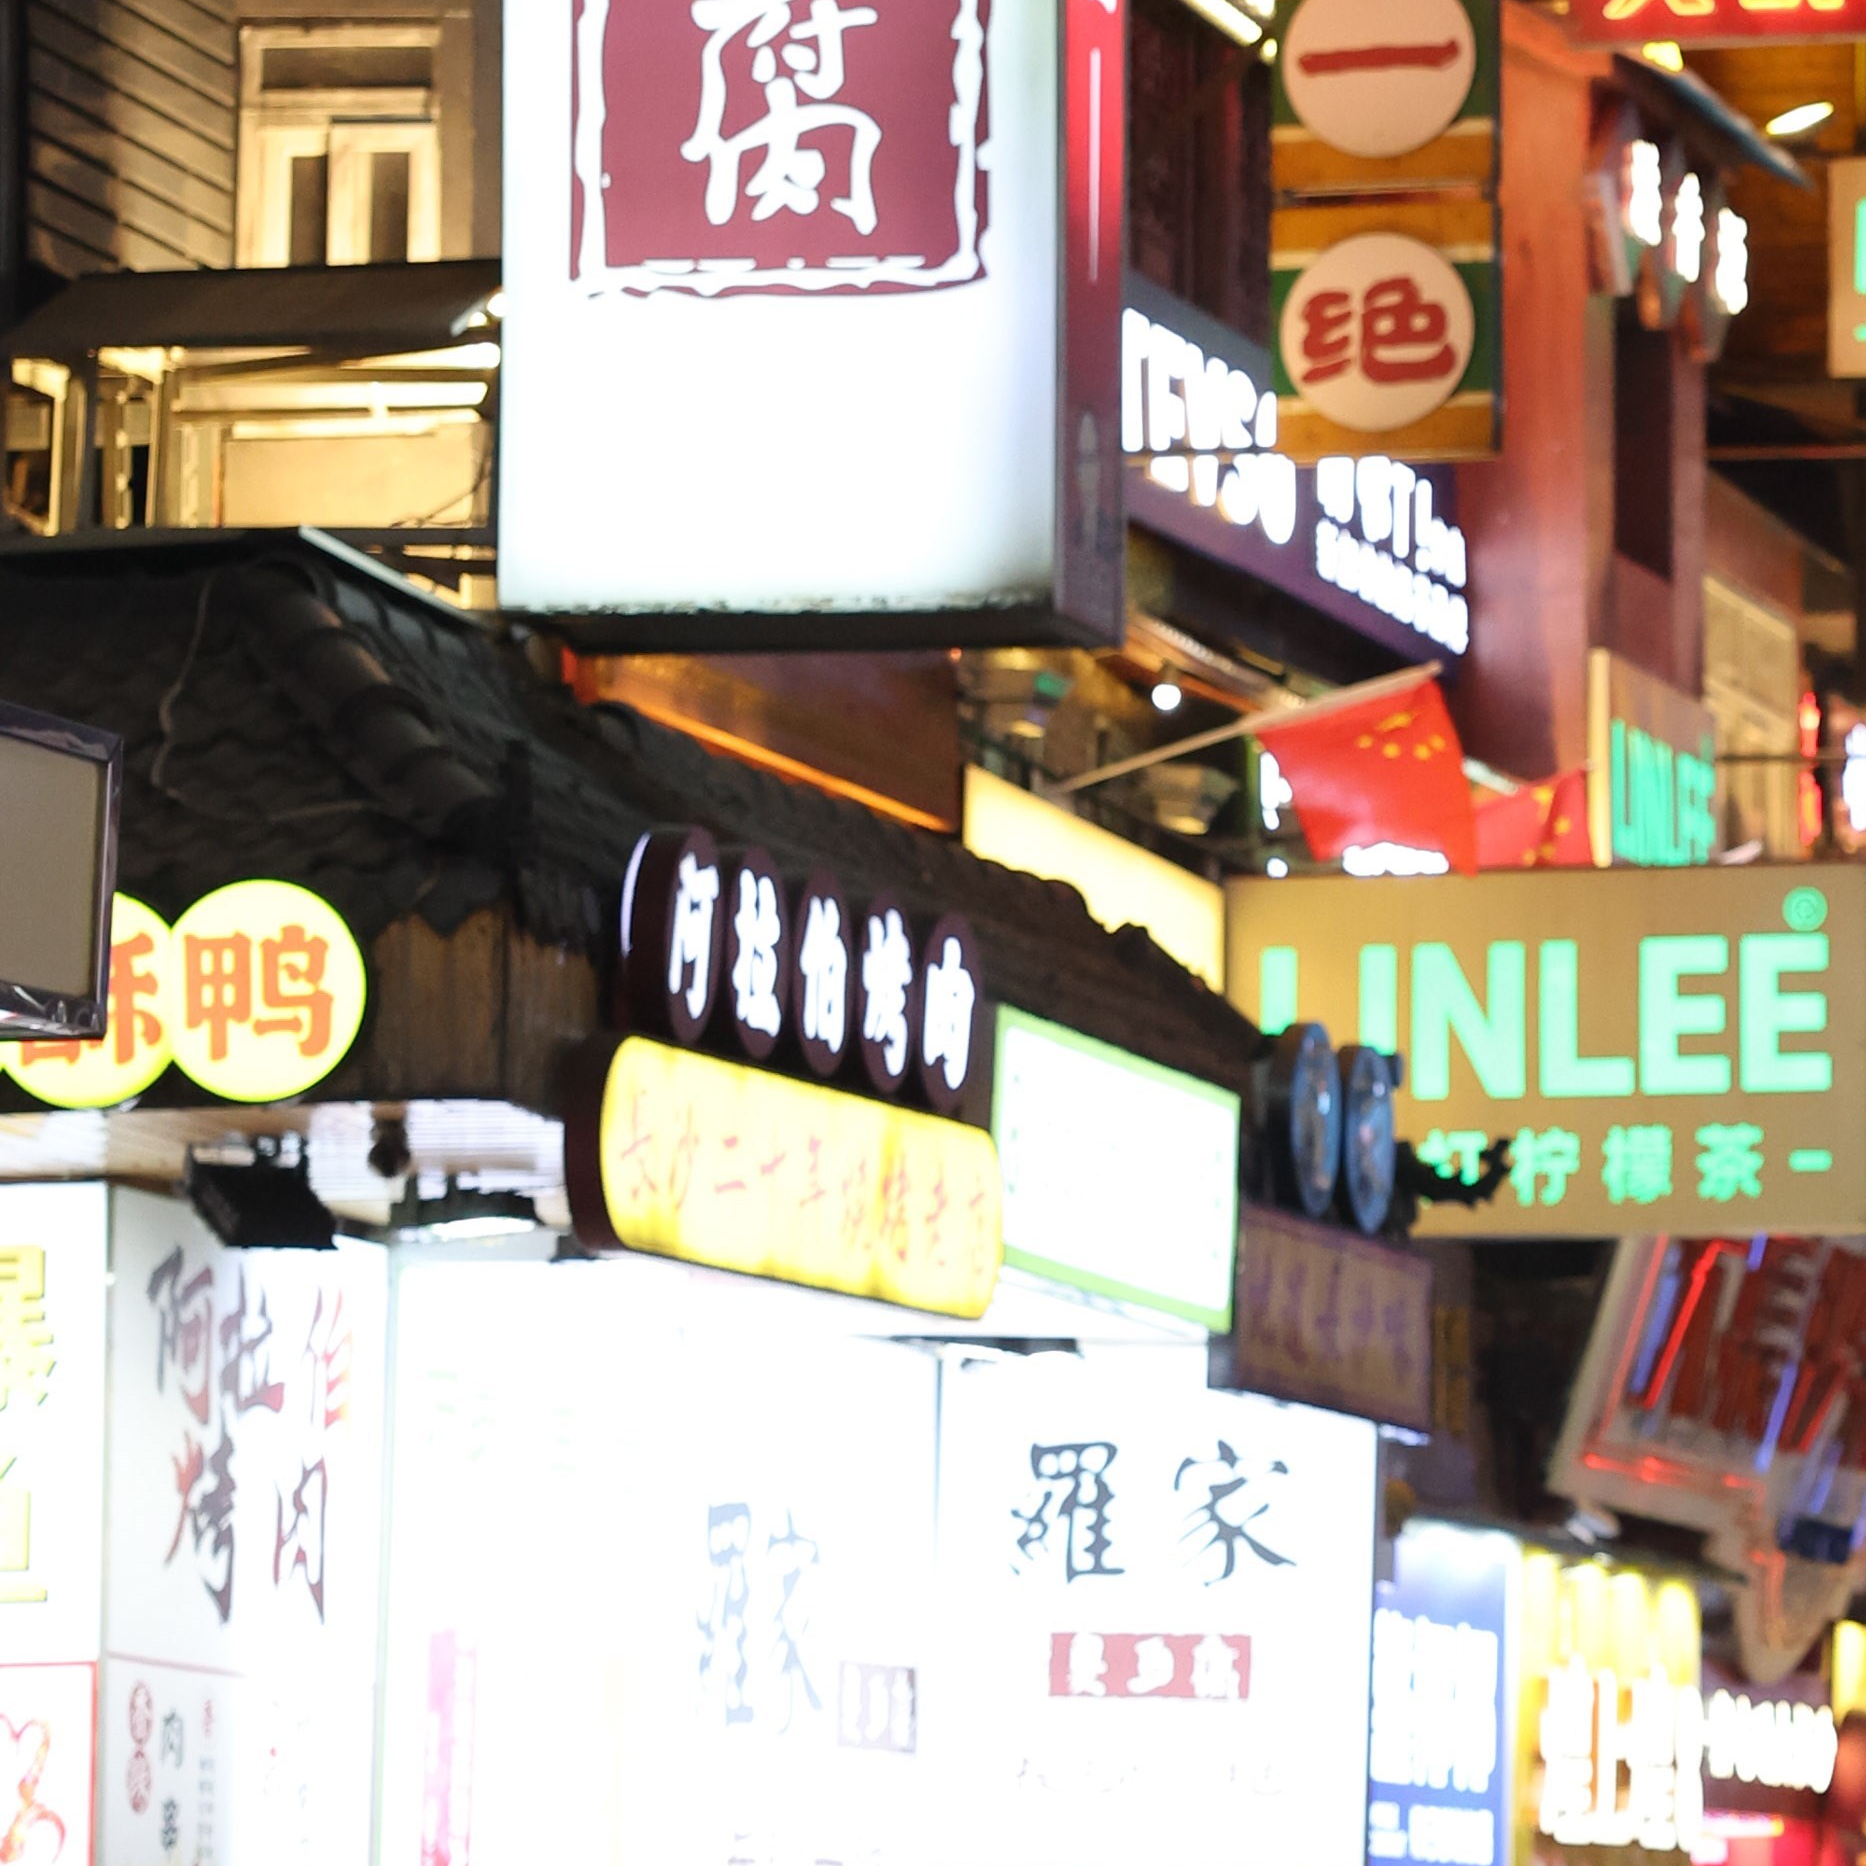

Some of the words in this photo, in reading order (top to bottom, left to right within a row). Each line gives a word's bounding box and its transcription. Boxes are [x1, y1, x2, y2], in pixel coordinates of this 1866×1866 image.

[668, 851, 976, 1090] 阿拉伯烤肉
